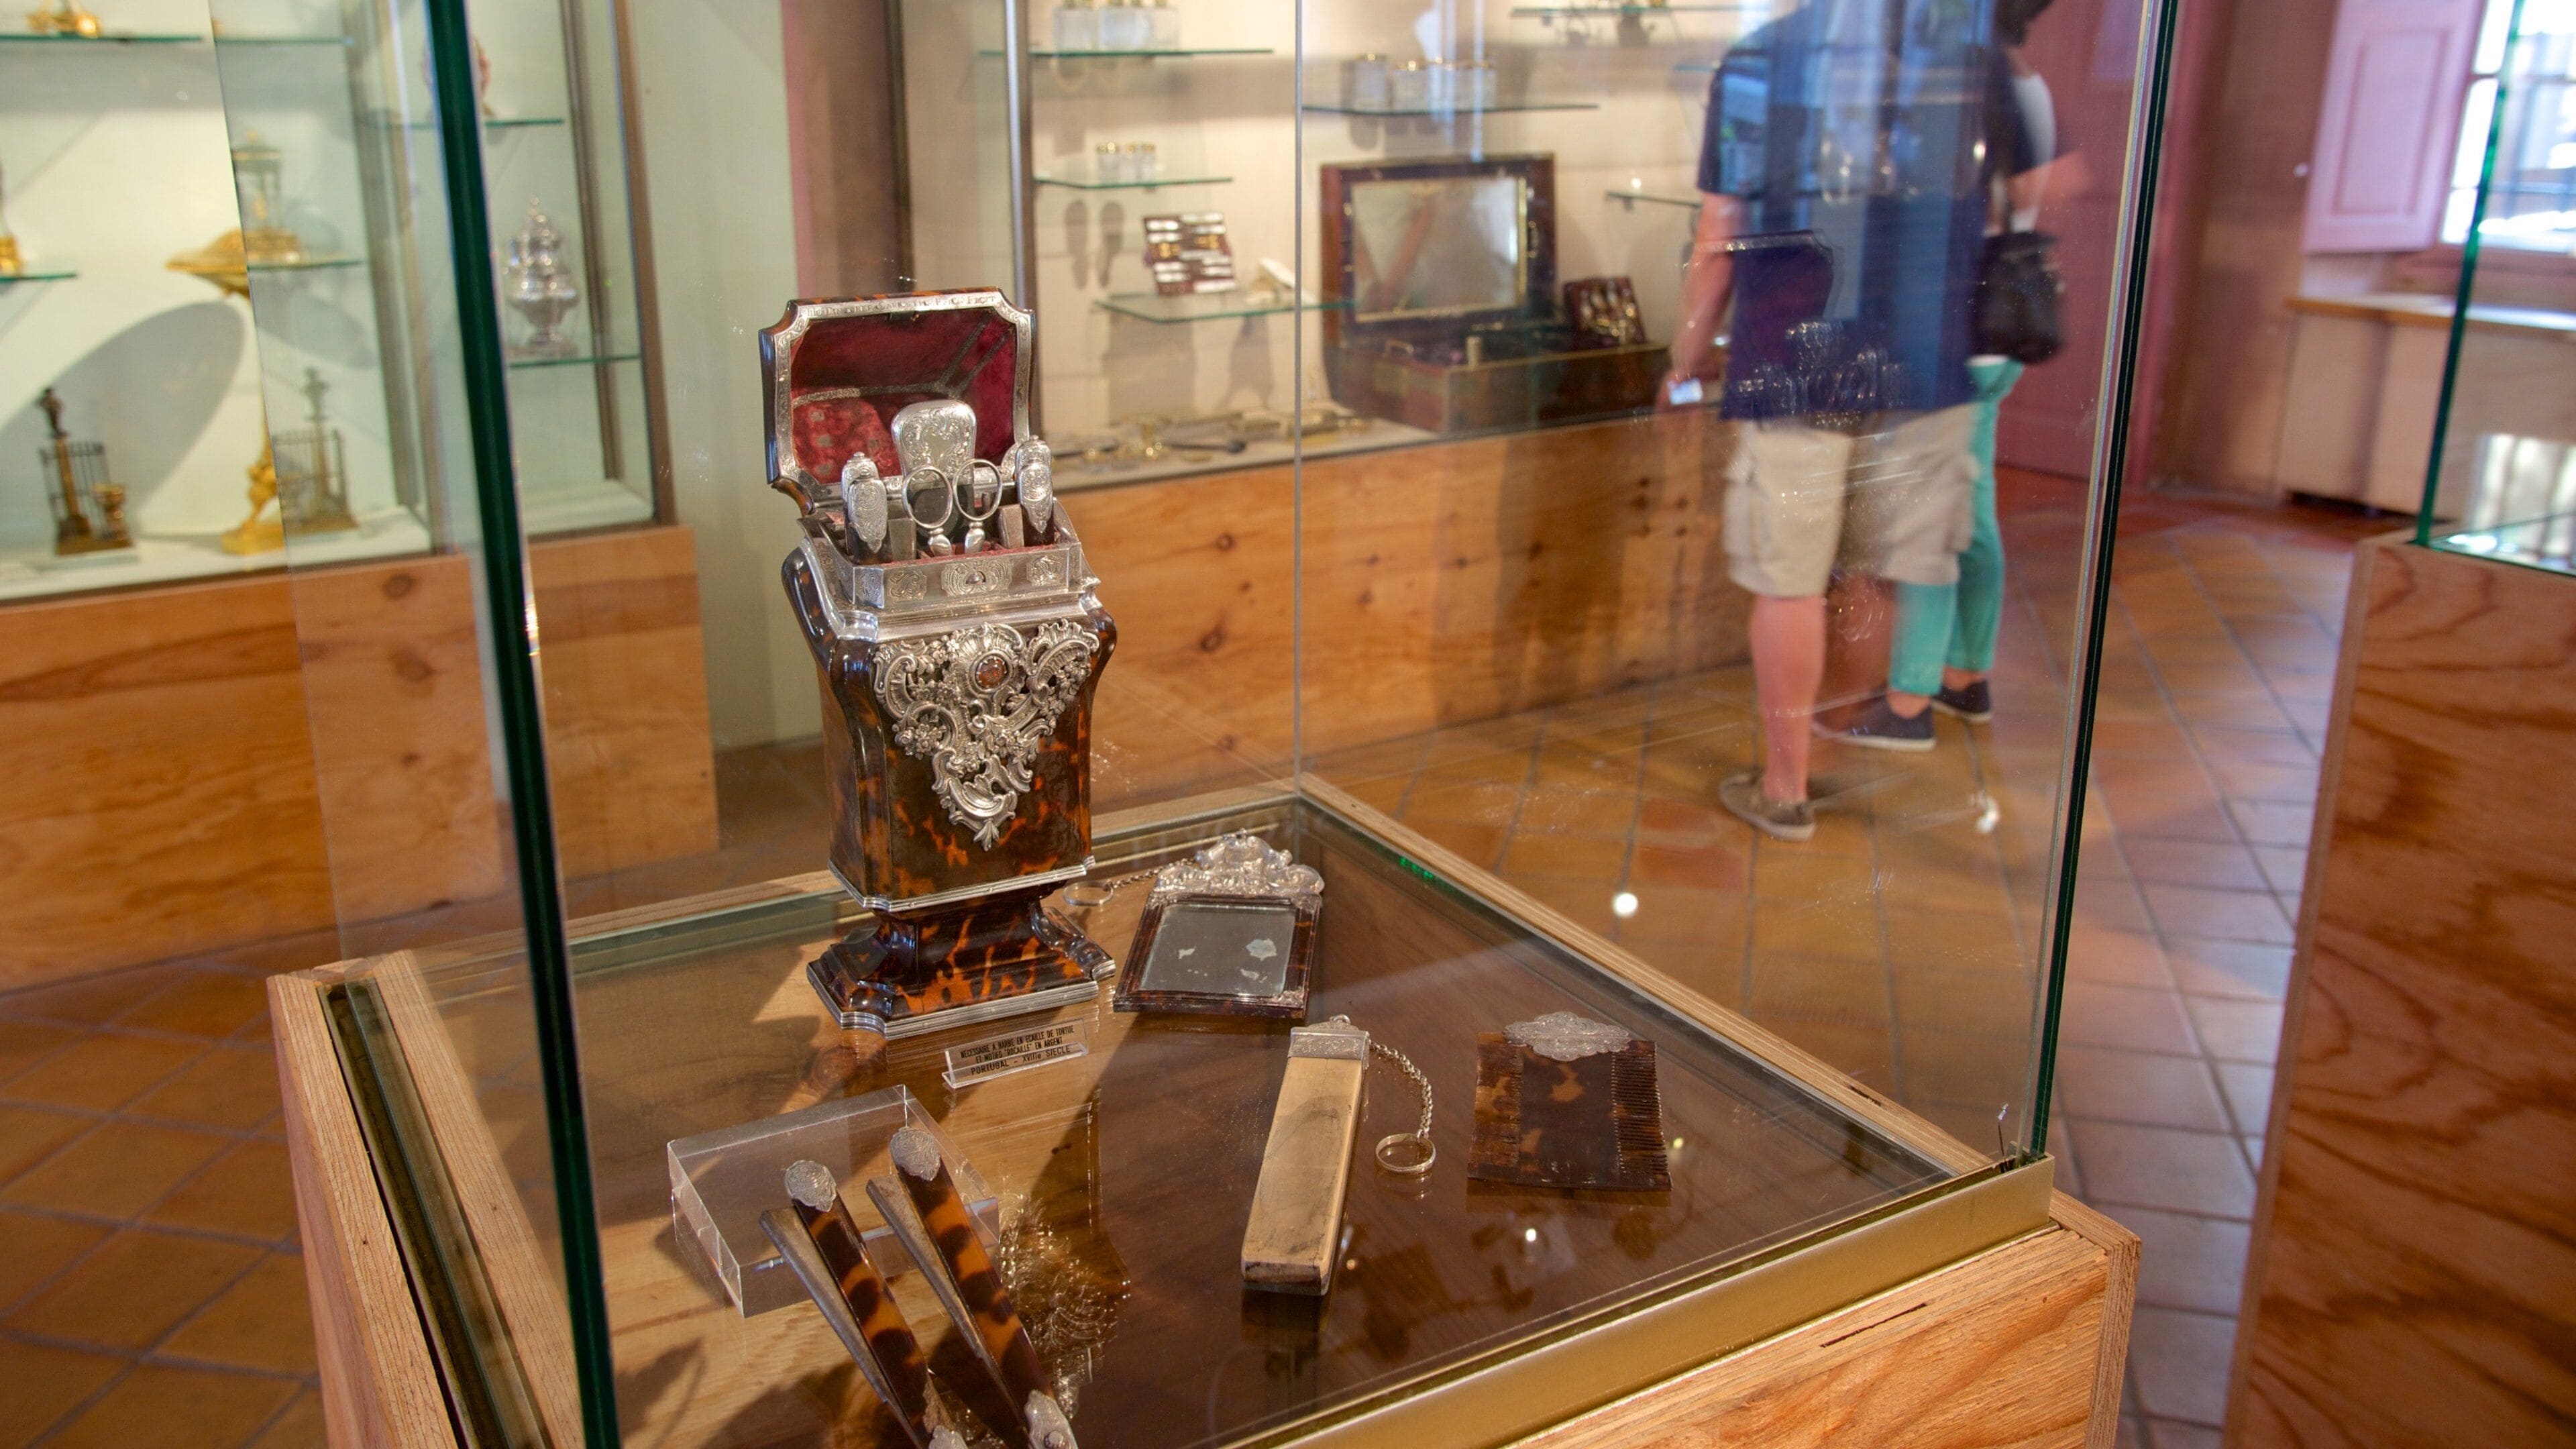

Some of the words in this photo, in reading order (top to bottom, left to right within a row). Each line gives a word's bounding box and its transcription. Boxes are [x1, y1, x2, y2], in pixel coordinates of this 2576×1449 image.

[960, 1044, 990, 1059] NECESSAIRE
[998, 1038, 1015, 1049] BARBE
[1016, 1036, 1024, 1045] EN
[1025, 1031, 1045, 1042] ECAILLE
[1046, 1029, 1054, 1038] DE
[1055, 1025, 1074, 1036] TORTUE
[975, 1055, 982, 1064] ET
[984, 1051, 1003, 1061] MOTIFS
[1034, 1040, 1042, 1050] EN
[1044, 1036, 1063, 1047] ARGENT
[971, 1059, 1010, 1076] PORTUGAL
[1046, 1045, 1070, 1057] SIECLE
